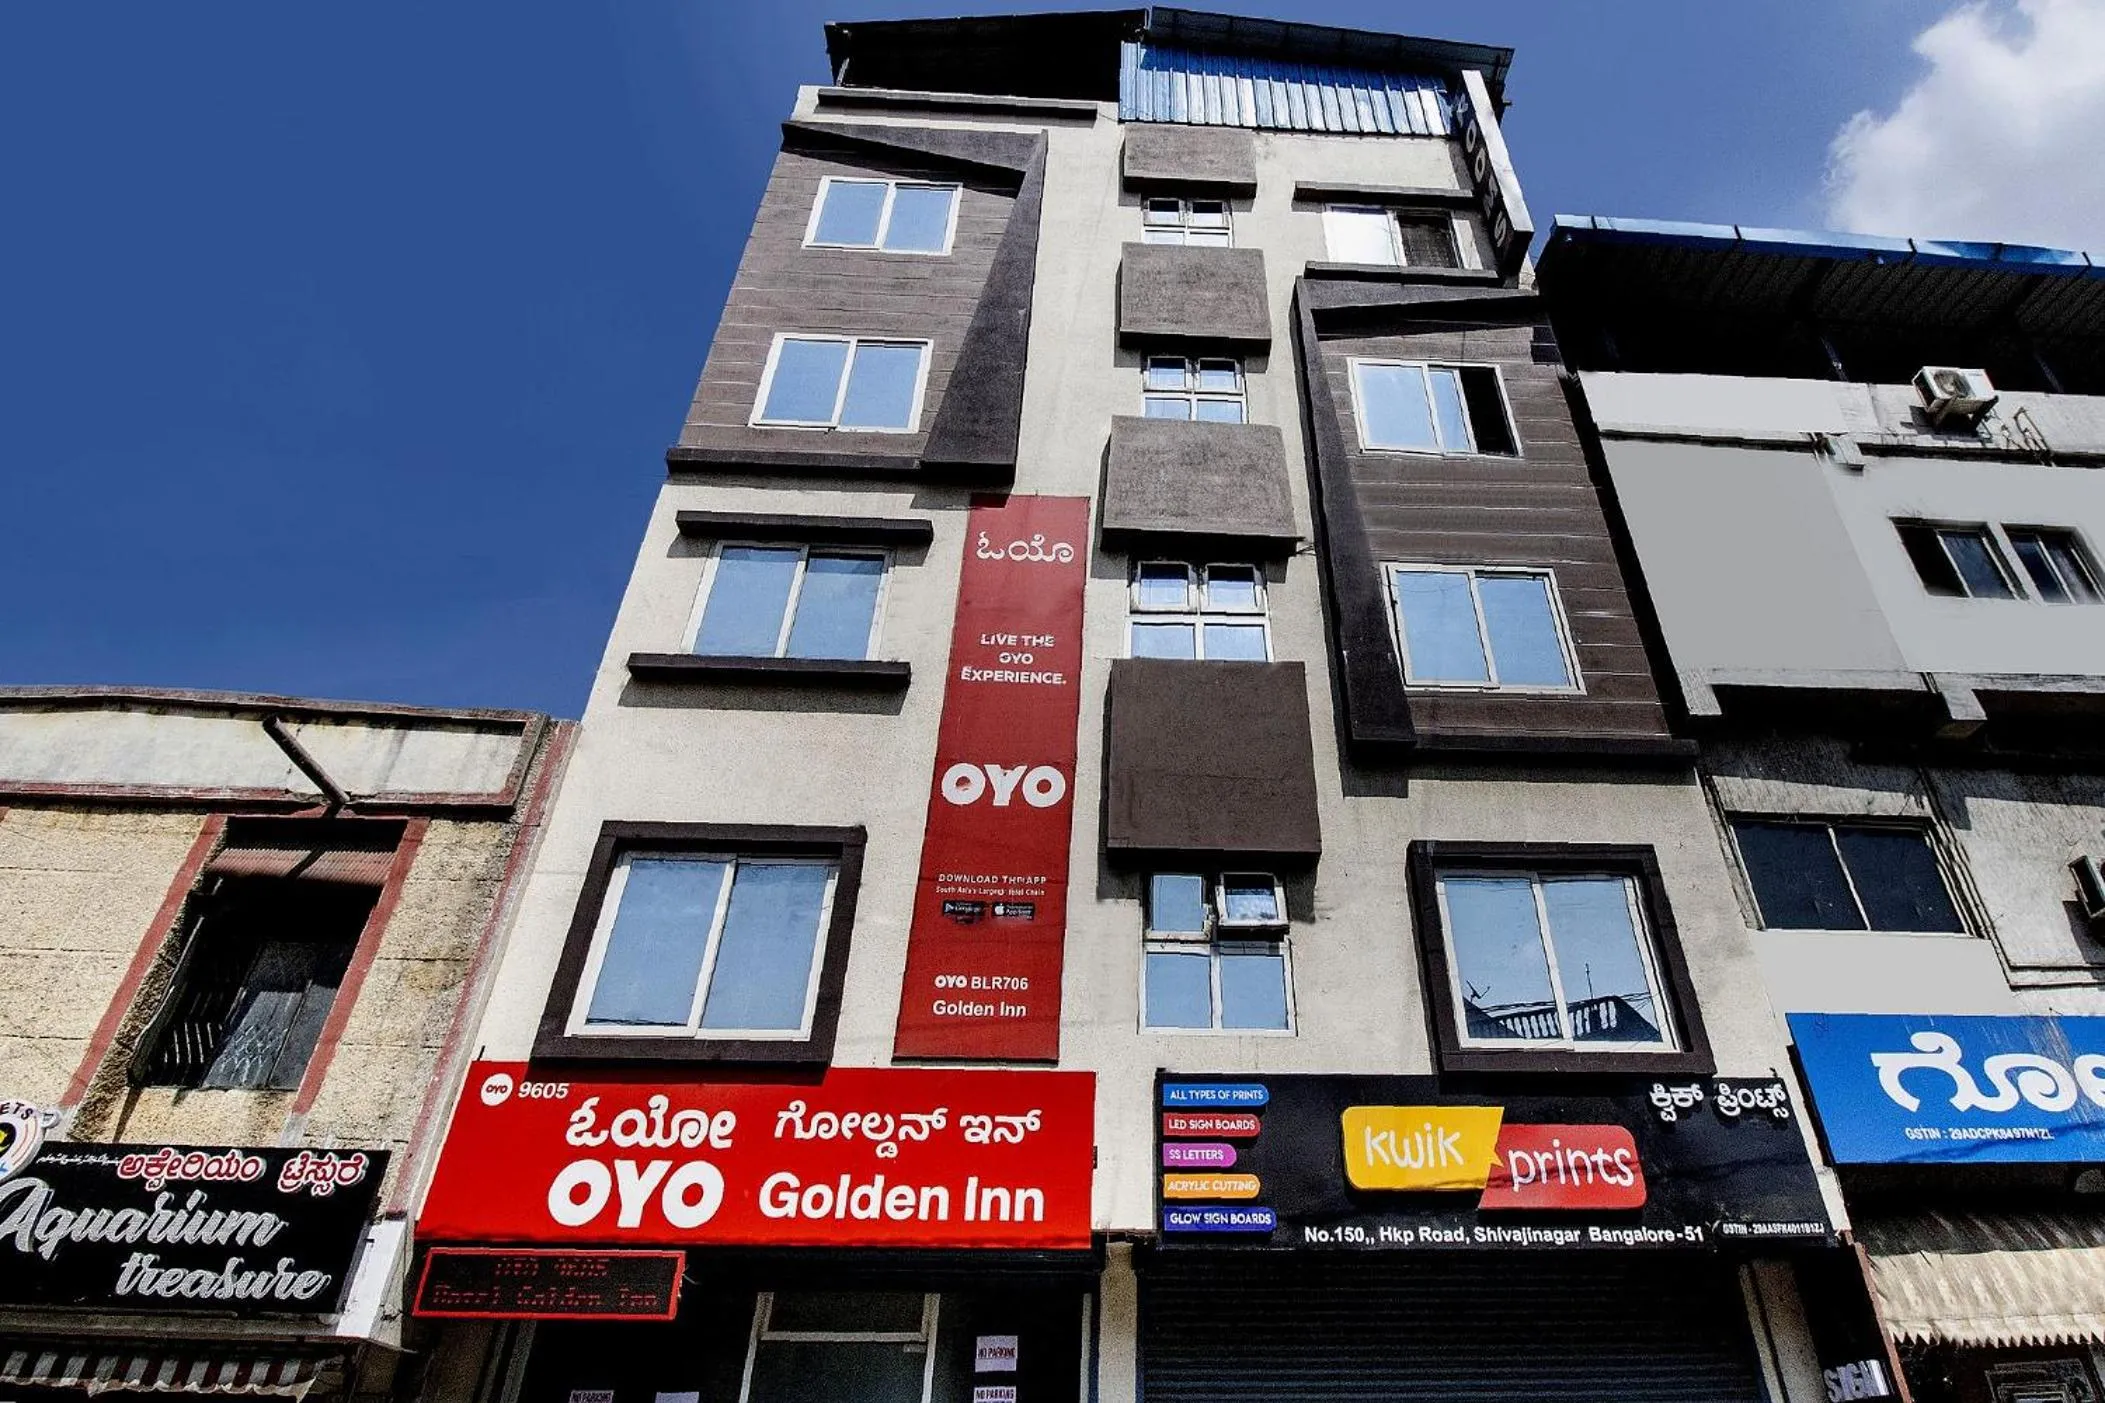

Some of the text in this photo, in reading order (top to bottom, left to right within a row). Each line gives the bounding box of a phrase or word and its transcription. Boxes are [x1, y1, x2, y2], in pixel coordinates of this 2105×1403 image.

[980, 633, 1055, 648] LIVE THE
[999, 652, 1034, 664] OYO
[961, 665, 1067, 685] EXPERIENCE.
[941, 763, 1066, 807] OYO
[938, 873, 999, 884] DOWNLOAD
[1024, 876, 1047, 885] APP
[936, 886, 956, 894] South
[934, 975, 1029, 990] OYO BLR706
[932, 1000, 1027, 1017] Golden Inn
[485, 1081, 570, 1099] OYO 9605
[1170, 1089, 1264, 1100] ALL TYPES OF PRINTS
[565, 1094, 1042, 1159] ಓಯೋ ಗೋಲ್ಡನ್ ಇನ್
[1168, 1119, 1256, 1130] LED SIGN BOARDS
[1905, 1127, 1941, 1140] GSTIN
[1364, 1123, 1464, 1168] kwik
[1168, 1149, 1224, 1160] SS LETTERS
[1508, 1139, 1634, 1192] prints
[547, 1159, 1045, 1229] OYO Golden Inn
[1168, 1180, 1257, 1191] ACRYLIC CUTTING
[0, 1177, 289, 1260] Aquarium
[1169, 1212, 1272, 1225] GLOW SIGN BOARDS
[1379, 1226, 1415, 1245] Hkp
[1418, 1226, 1471, 1244] Road,
[1473, 1226, 1581, 1246] Shivajinagar
[115, 1251, 331, 1301] treasure
[1823, 1359, 1889, 1403] SIGN
